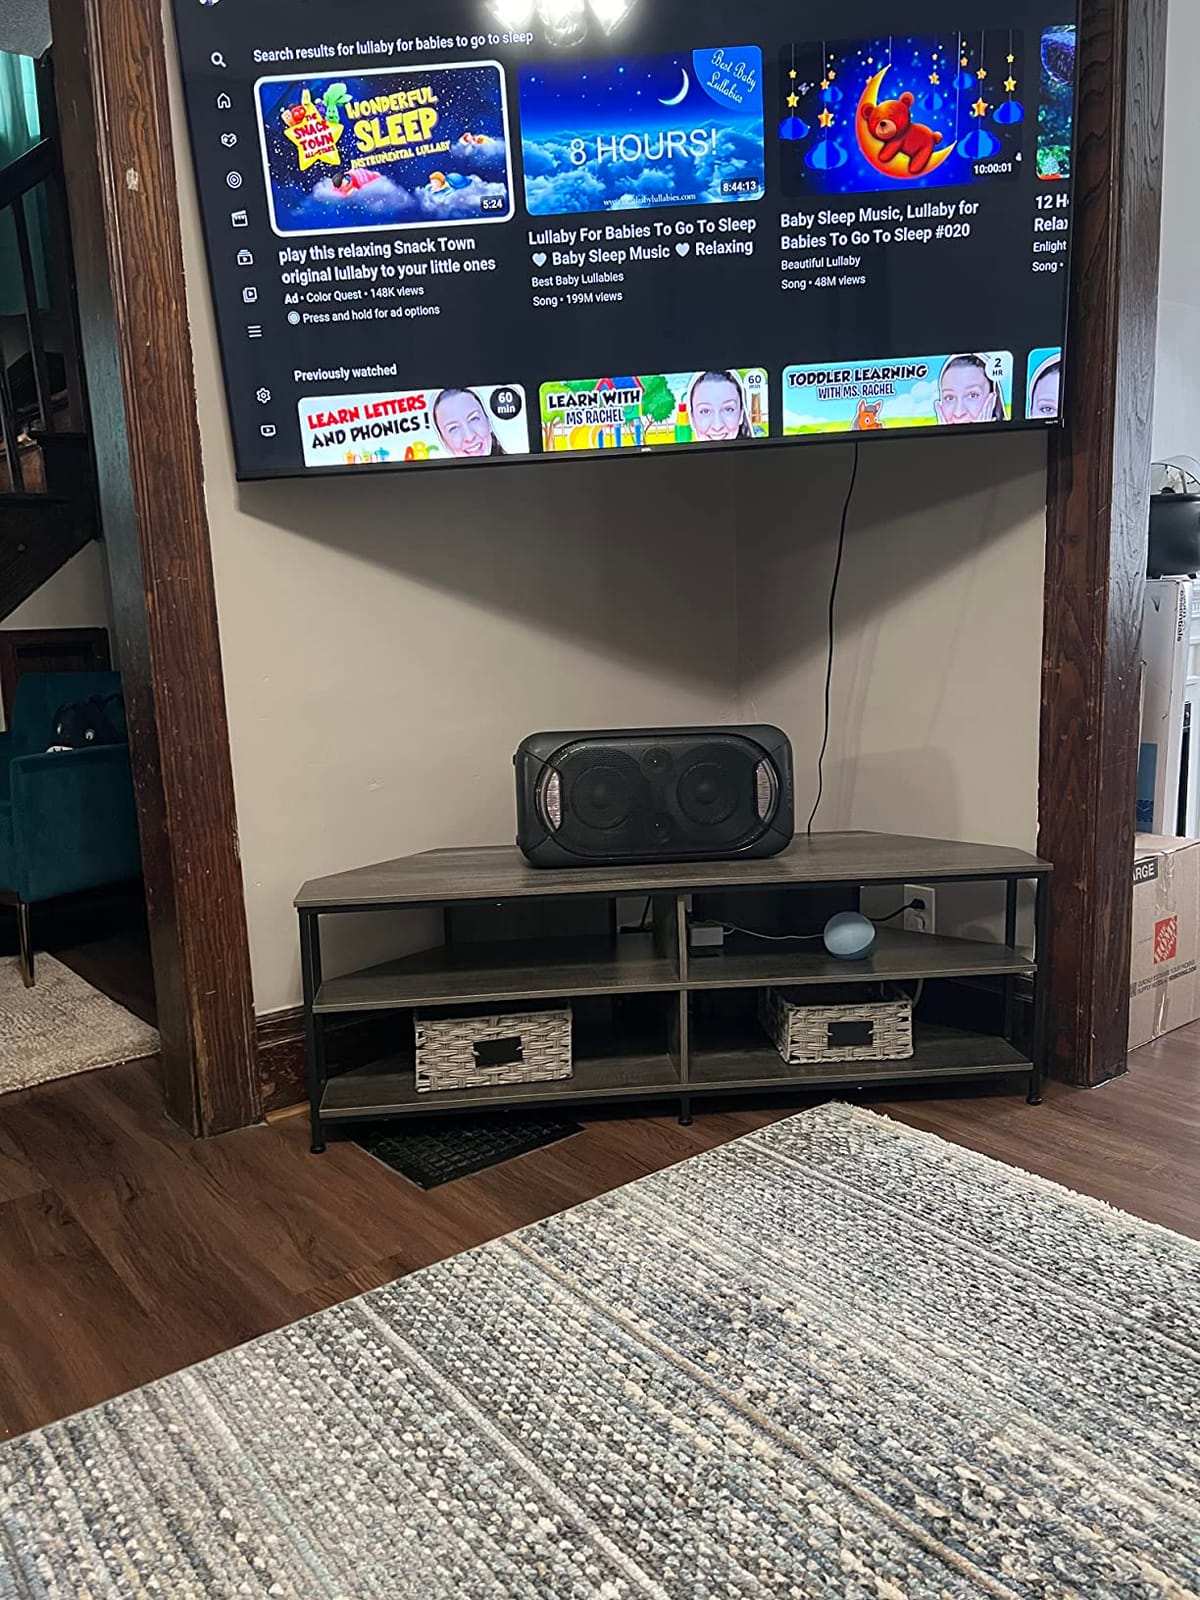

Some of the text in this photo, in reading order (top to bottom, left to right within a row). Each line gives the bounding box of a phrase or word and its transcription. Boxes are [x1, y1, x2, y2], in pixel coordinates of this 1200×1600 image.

[253, 31, 534, 62] Search results for lullaby for babies to go to sleep
[345, 86, 438, 119] WONDERFUL
[293, 119, 330, 139] SNACK
[354, 107, 438, 152] SLEEP
[300, 132, 334, 151] TOWN
[569, 128, 718, 166] 8 HOURS!
[351, 140, 451, 169] INSTRUMENTAL LULLABY
[974, 162, 1012, 175] 10:00:01
[722, 180, 757, 192] 8:44:13
[482, 195, 503, 210] 5:24
[1035, 193, 1070, 209] 12 H
[780, 200, 979, 229] Baby Sleep Music, Lullaby for
[528, 217, 757, 246] Lullaby For Babies To Go To Sleep
[780, 223, 971, 250] Babies To Go To Sleep #020
[279, 237, 476, 266] play this relaxing Snack Town
[552, 240, 754, 267] Baby Sleep Music Relaxing
[780, 254, 861, 271] Beautiful Lullaby
[1031, 261, 1058, 273] Song
[281, 258, 497, 287] original lullaby to your little ones
[531, 271, 625, 288] Best Baby Lullabies
[780, 273, 866, 292] Song 48M views
[284, 285, 425, 305] Ad Color Quest 148K views
[532, 290, 623, 308] Song 199M views
[302, 304, 441, 324] Press and hold for ad options
[994, 357, 1002, 368] 2
[294, 363, 398, 382] Previously watched
[748, 374, 762, 384] 60
[788, 365, 928, 387] TODDLER LEARNING
[992, 369, 1003, 377] HR
[498, 391, 513, 404] 60
[549, 390, 641, 409] LEARN WITH
[818, 383, 895, 399] WITH MS. RACHEL
[307, 394, 428, 430] LEARN LETTERS
[497, 403, 516, 413] min
[566, 408, 624, 425] MS RACHEL
[312, 429, 347, 449] AND
